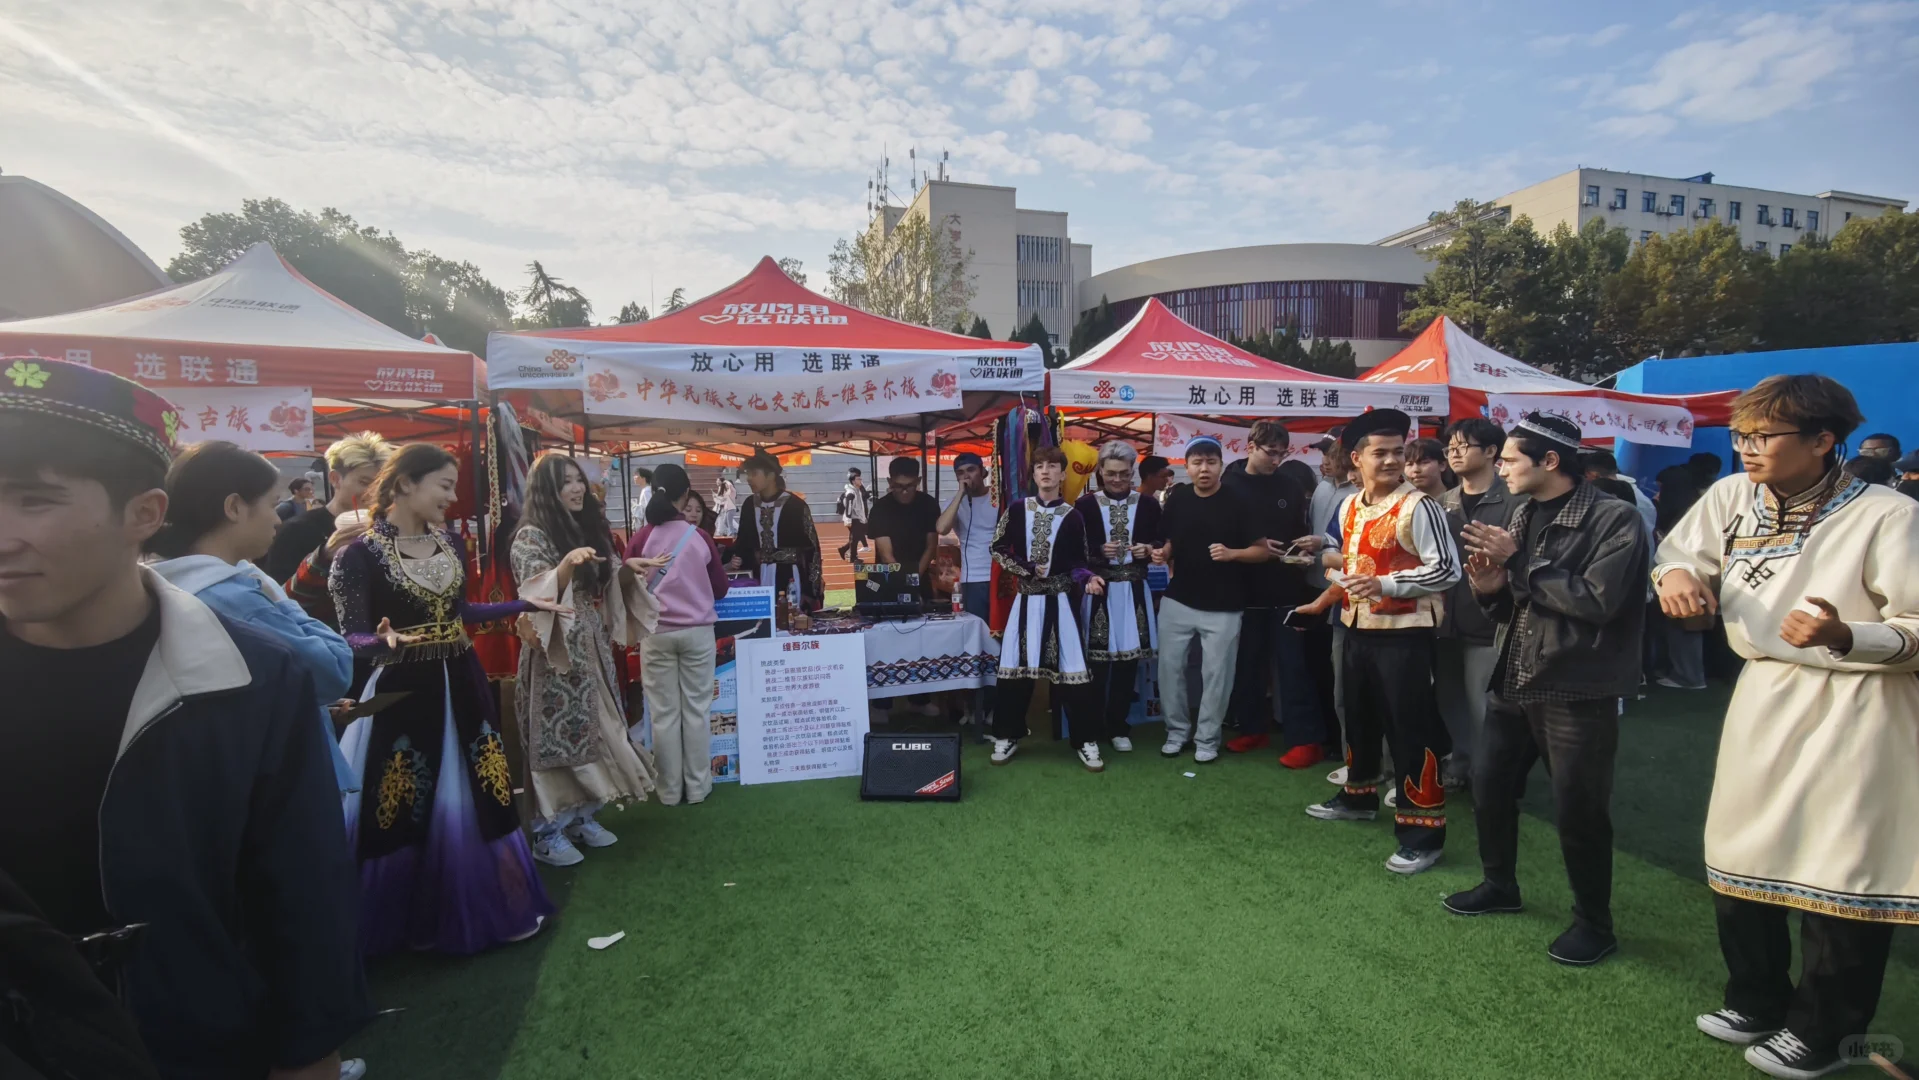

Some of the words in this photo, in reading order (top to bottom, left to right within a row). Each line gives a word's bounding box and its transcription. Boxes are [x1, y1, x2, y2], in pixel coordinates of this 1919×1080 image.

[721, 303, 829, 315] 放心用
[737, 314, 849, 325] 选联通
[1148, 341, 1234, 358] 放心用
[691, 352, 774, 373] 放心用
[802, 352, 881, 373] 选联通
[977, 356, 1017, 367] 放心用
[1171, 351, 1258, 368] 选联通
[134, 352, 259, 385] 选联通
[376, 367, 435, 380] 放心用
[983, 367, 1024, 379] 选联通
[383, 380, 444, 393] 选联通
[1120, 388, 1134, 399] 95
[1189, 385, 1255, 406] 放心用
[1276, 387, 1340, 408] 选联通
[1400, 395, 1430, 405] 放心用
[782, 640, 820, 652] 维吾尔族
[760, 659, 786, 667] 挑战类型
[892, 743, 931, 751] CUBE
